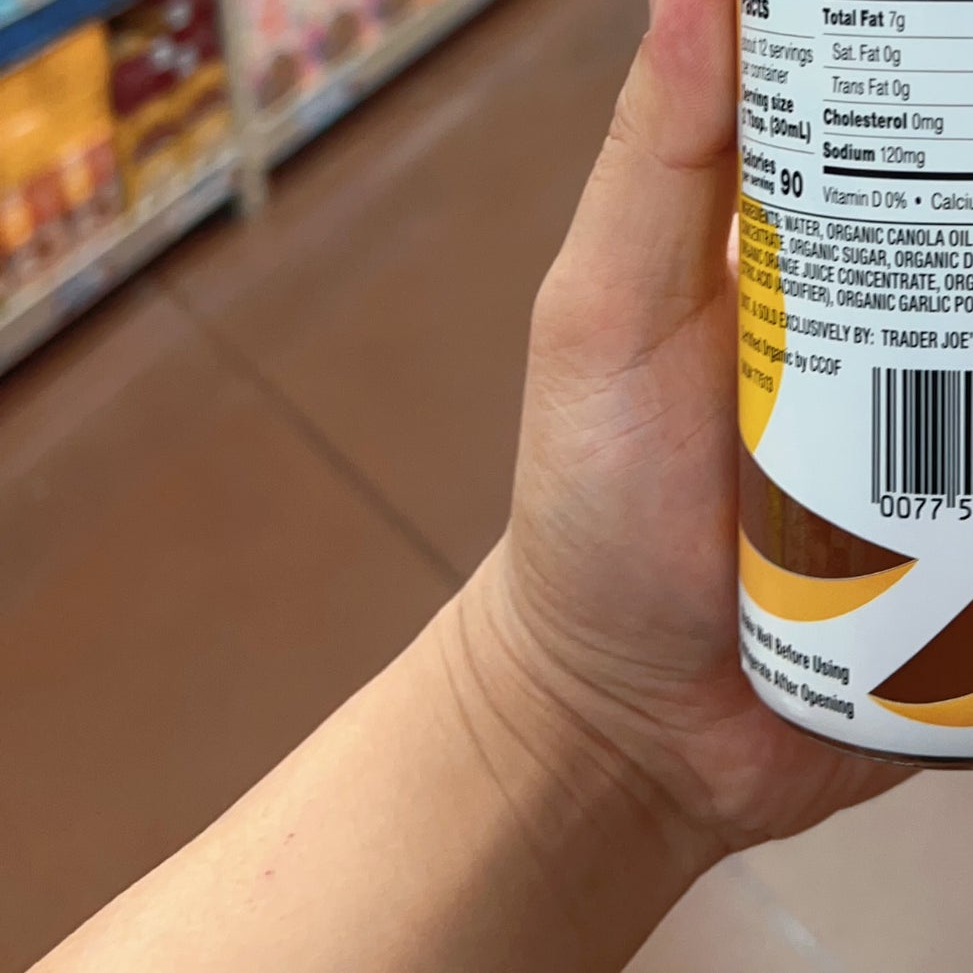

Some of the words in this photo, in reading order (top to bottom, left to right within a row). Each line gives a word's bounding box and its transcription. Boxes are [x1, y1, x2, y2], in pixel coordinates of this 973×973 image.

[822, 8, 856, 26] Total
[860, 9, 884, 27] Fat
[889, 11, 905, 32] 7g
[769, 41, 814, 67] servings
[860, 44, 880, 62] Fat
[883, 45, 901, 67] 0g
[832, 76, 864, 95] Trans
[868, 78, 889, 97] Fat
[892, 79, 910, 101] 0g
[771, 93, 795, 113] size
[770, 115, 811, 145] (30mL)
[823, 108, 907, 130] Cholesterol
[912, 112, 944, 134] 0mg
[823, 141, 875, 162] Sodium
[881, 145, 925, 168] 120mg
[781, 168, 803, 198] 90
[823, 186, 869, 207] Vitamin
[872, 191, 882, 208] D
[885, 191, 907, 209] 0%
[826, 222, 884, 245] ORGANIC
[887, 228, 945, 246] CANOLA
[789, 237, 839, 262] ORGANIC
[842, 246, 891, 269] SUGAR,
[895, 250, 959, 268] ORGANIC
[802, 262, 835, 283] JUICE
[838, 267, 940, 293] CONCENTRATE,
[837, 289, 895, 311] ORGANIC
[899, 294, 950, 313] GARLIC
[779, 311, 851, 342] EXCLUSIVELY
[853, 326, 875, 346] BY:
[881, 329, 938, 349] TRADER
[795, 350, 807, 373] by
[810, 354, 842, 376] CCOF
[880, 494, 943, 520] 0077
[775, 637, 810, 670] Before
[813, 654, 849, 686] Using
[801, 683, 854, 720] Opening
